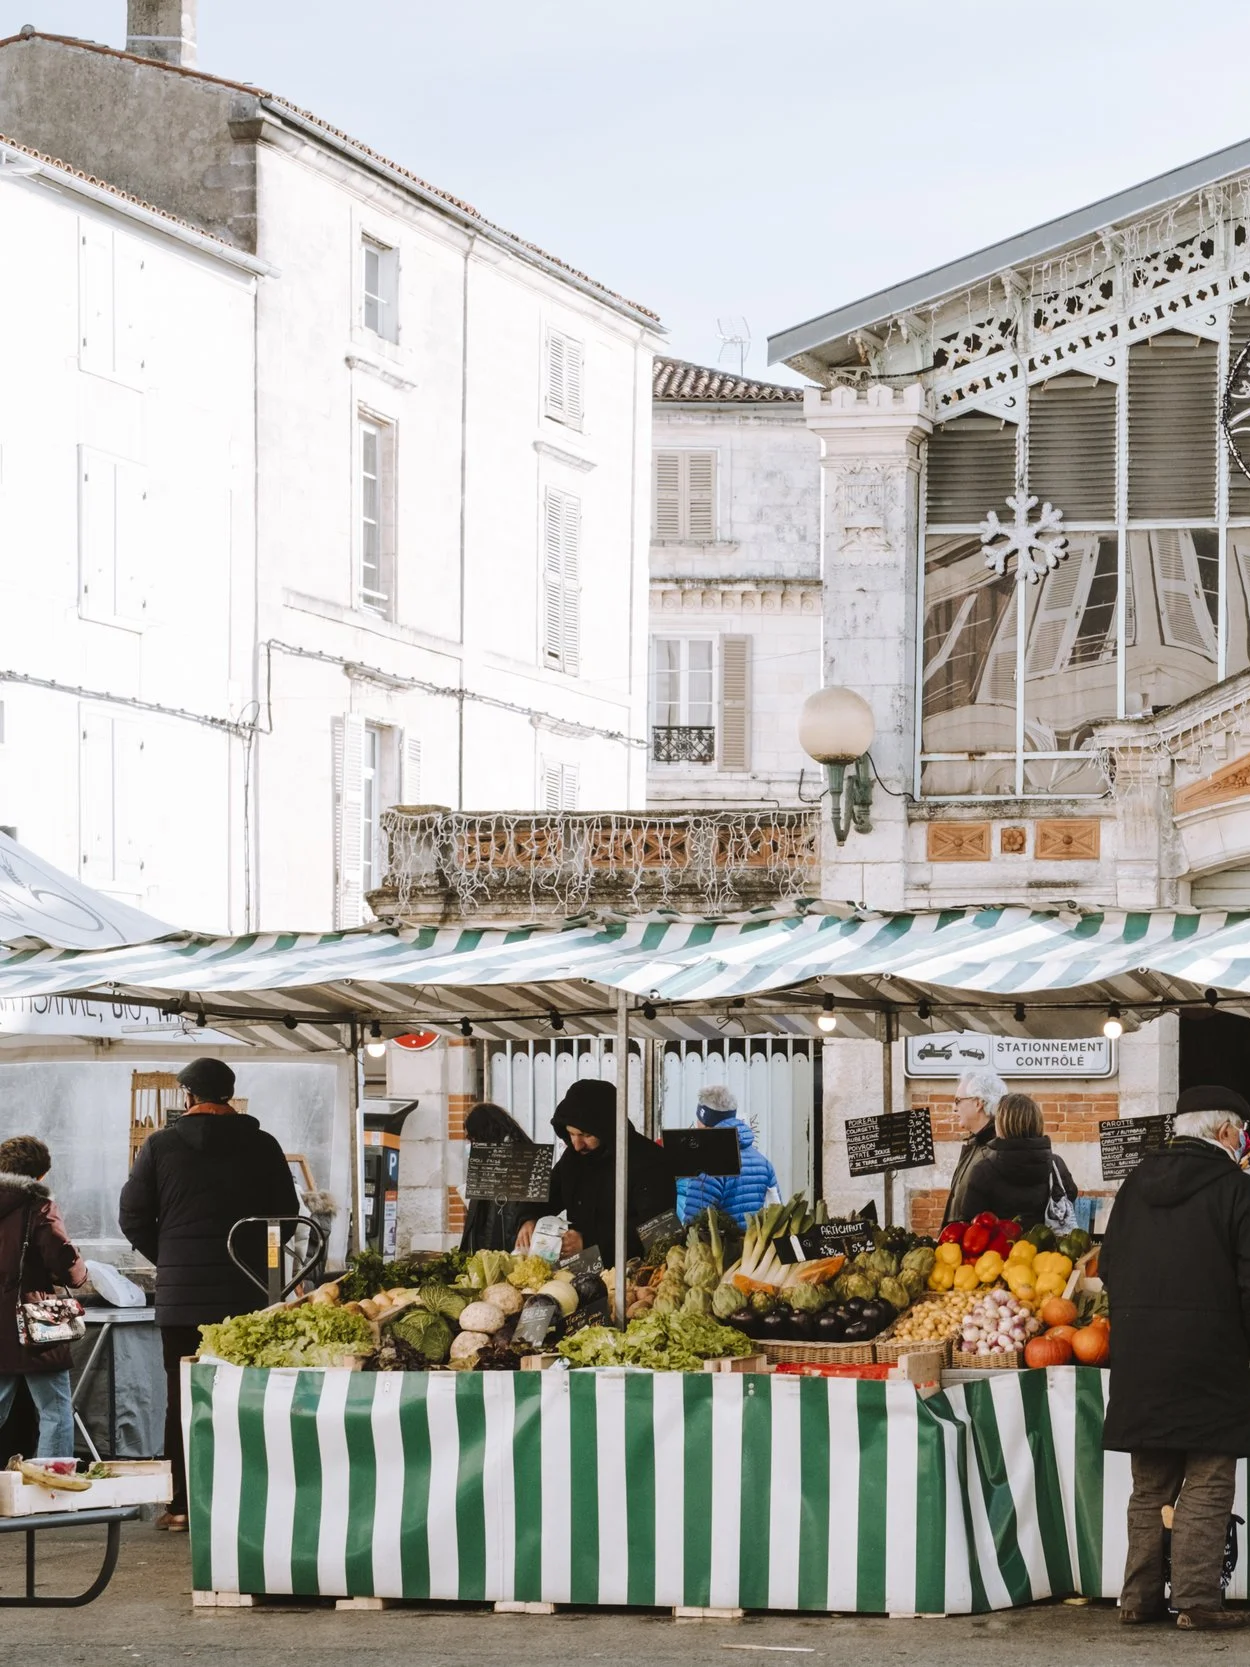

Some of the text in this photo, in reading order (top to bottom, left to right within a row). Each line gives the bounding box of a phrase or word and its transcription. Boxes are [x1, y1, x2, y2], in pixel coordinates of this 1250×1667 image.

[997, 1042, 1104, 1052] STATIONNEMENT
[1016, 1054, 1084, 1066] CONTRÔLÉ
[848, 1117, 878, 1126] POIREAU
[1101, 1119, 1134, 1128] CAROTTE
[846, 1125, 880, 1135] COURGETTE
[847, 1133, 880, 1142] AUBERGINE
[389, 1153, 397, 1176] P
[820, 1222, 864, 1235] ARTICHAUT
